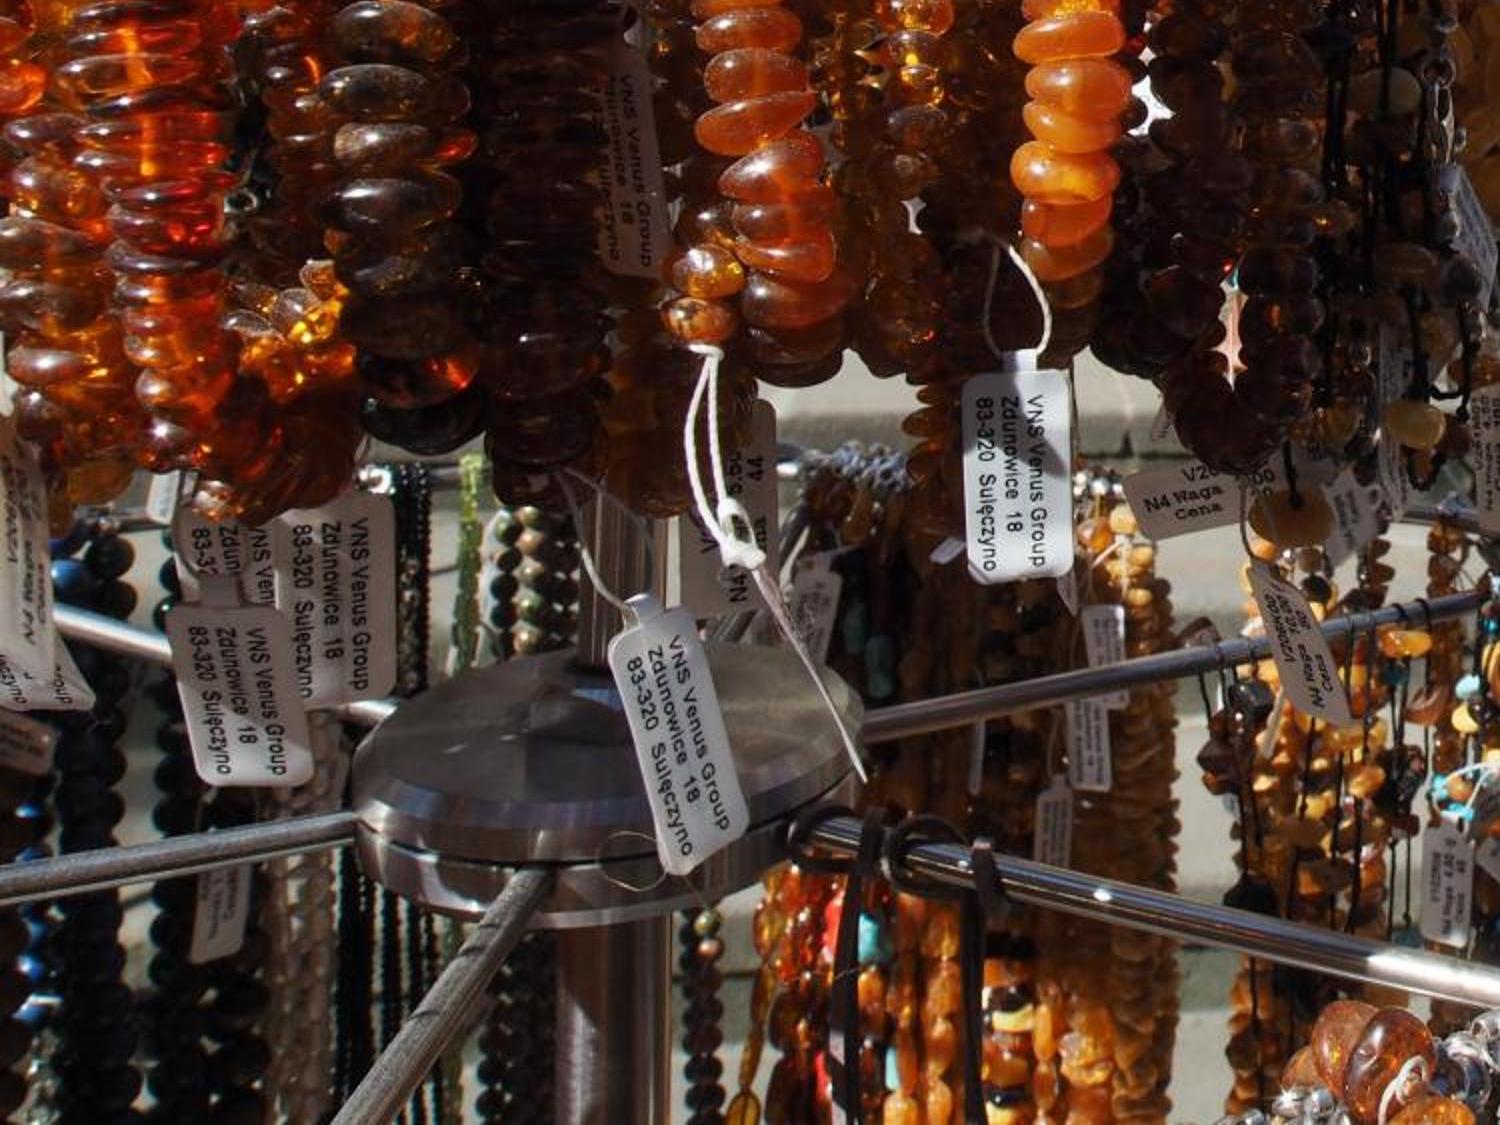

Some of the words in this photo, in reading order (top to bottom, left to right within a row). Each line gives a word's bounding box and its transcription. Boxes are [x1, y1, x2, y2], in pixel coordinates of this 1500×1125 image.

[635, 200, 652, 267] Group
[976, 397, 996, 463] 83-320
[1001, 395, 1020, 501] Zdunowice
[1027, 393, 1045, 441] VNS
[747, 454, 765, 483] 44
[1028, 442, 1046, 504] Venus
[977, 472, 998, 572] Sulęczyno
[1006, 513, 1023, 533] 18
[1143, 495, 1169, 514] N4
[1175, 501, 1222, 521] Cena
[292, 524, 314, 588] 83-320
[350, 517, 369, 561] VNS
[1029, 506, 1048, 568] Group
[321, 521, 342, 626] Zdunowice
[350, 565, 369, 627] Venus
[188, 626, 217, 682] 83-320
[246, 627, 268, 665] VNS
[323, 636, 344, 660] 18
[347, 632, 371, 691] Group
[216, 627, 251, 716] Zdunowice
[238, 725, 258, 745] 18
[254, 669, 277, 720] Venus
[201, 689, 234, 776] Sulęczyno
[263, 723, 288, 776] Group
[646, 644, 690, 766] Zdunowice
[683, 775, 702, 804] 18
[668, 634, 692, 695] VNS
[682, 692, 709, 761] Venus
[701, 763, 730, 831] Group
[626, 656, 658, 731] 83-320
[649, 741, 694, 858] Sulęczyno
